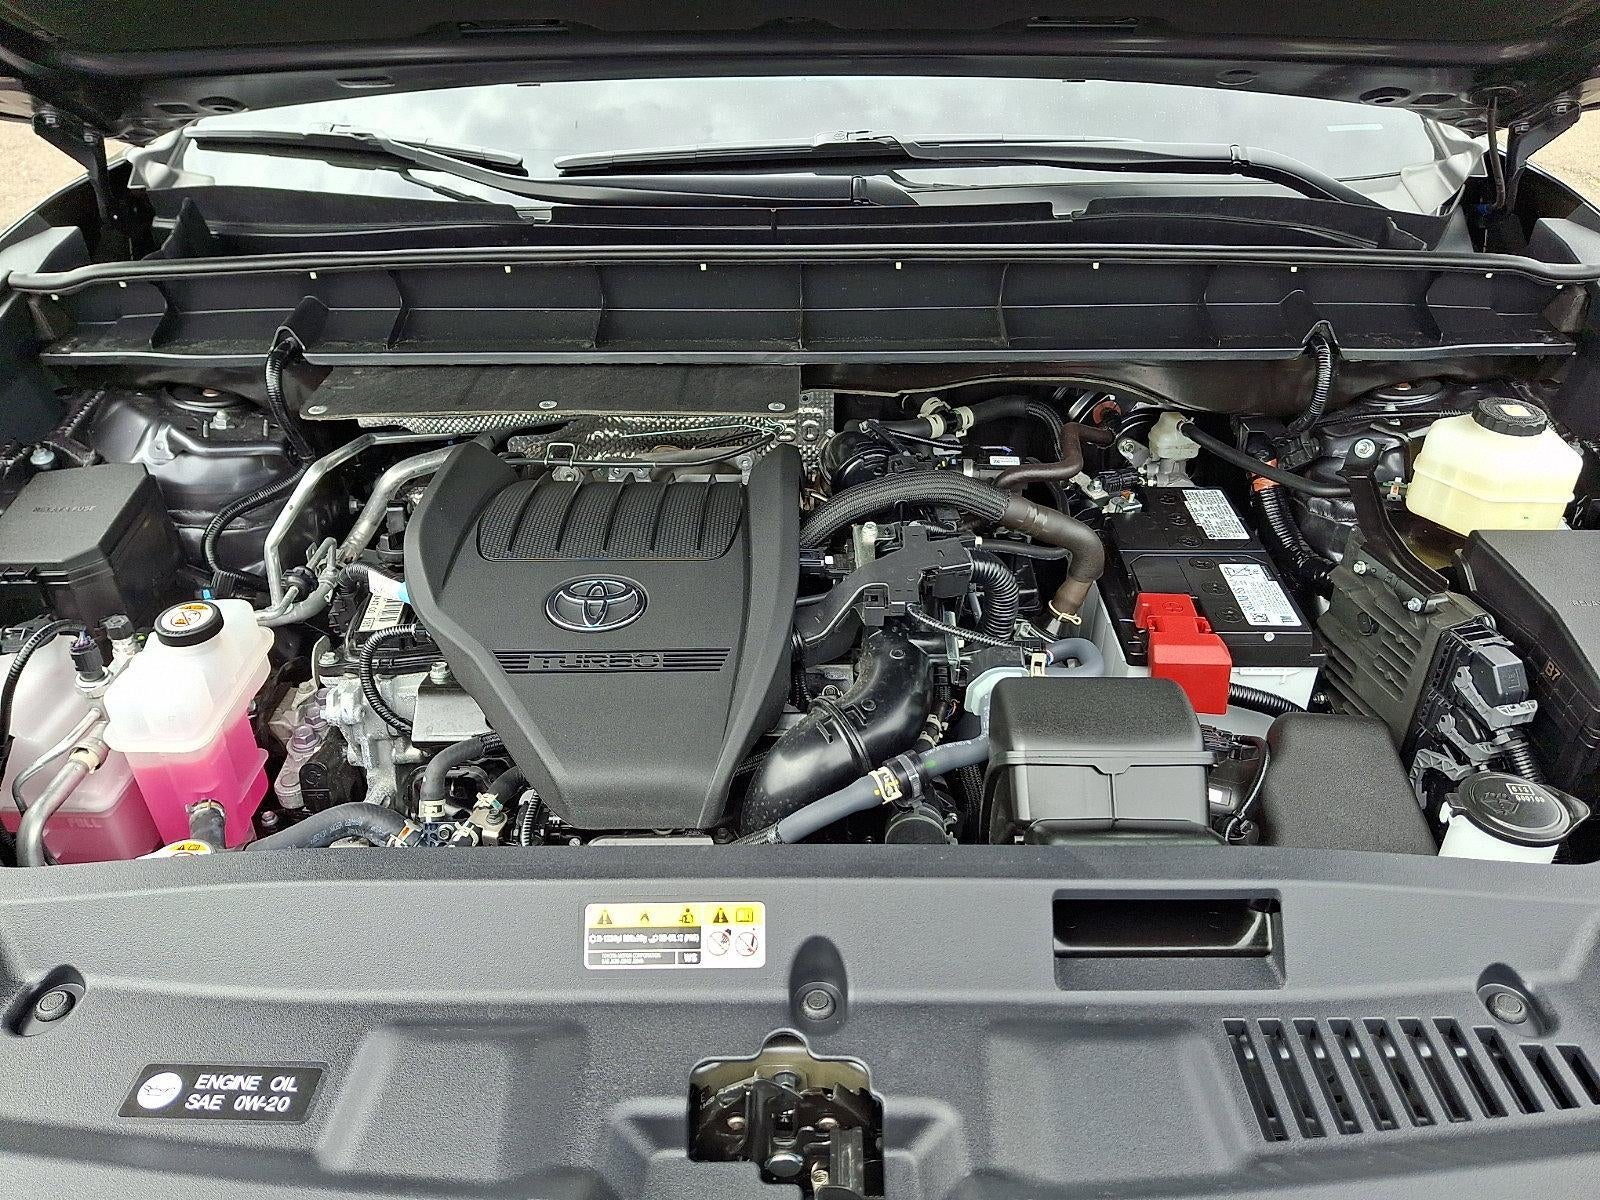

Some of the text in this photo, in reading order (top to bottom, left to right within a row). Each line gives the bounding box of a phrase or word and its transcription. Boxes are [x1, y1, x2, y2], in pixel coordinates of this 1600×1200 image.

[532, 652, 660, 669] TURBO
[1544, 660, 1561, 681] B7
[194, 1073, 298, 1092] ENGINE OIL
[184, 1093, 292, 1112] SAE 0W-20
